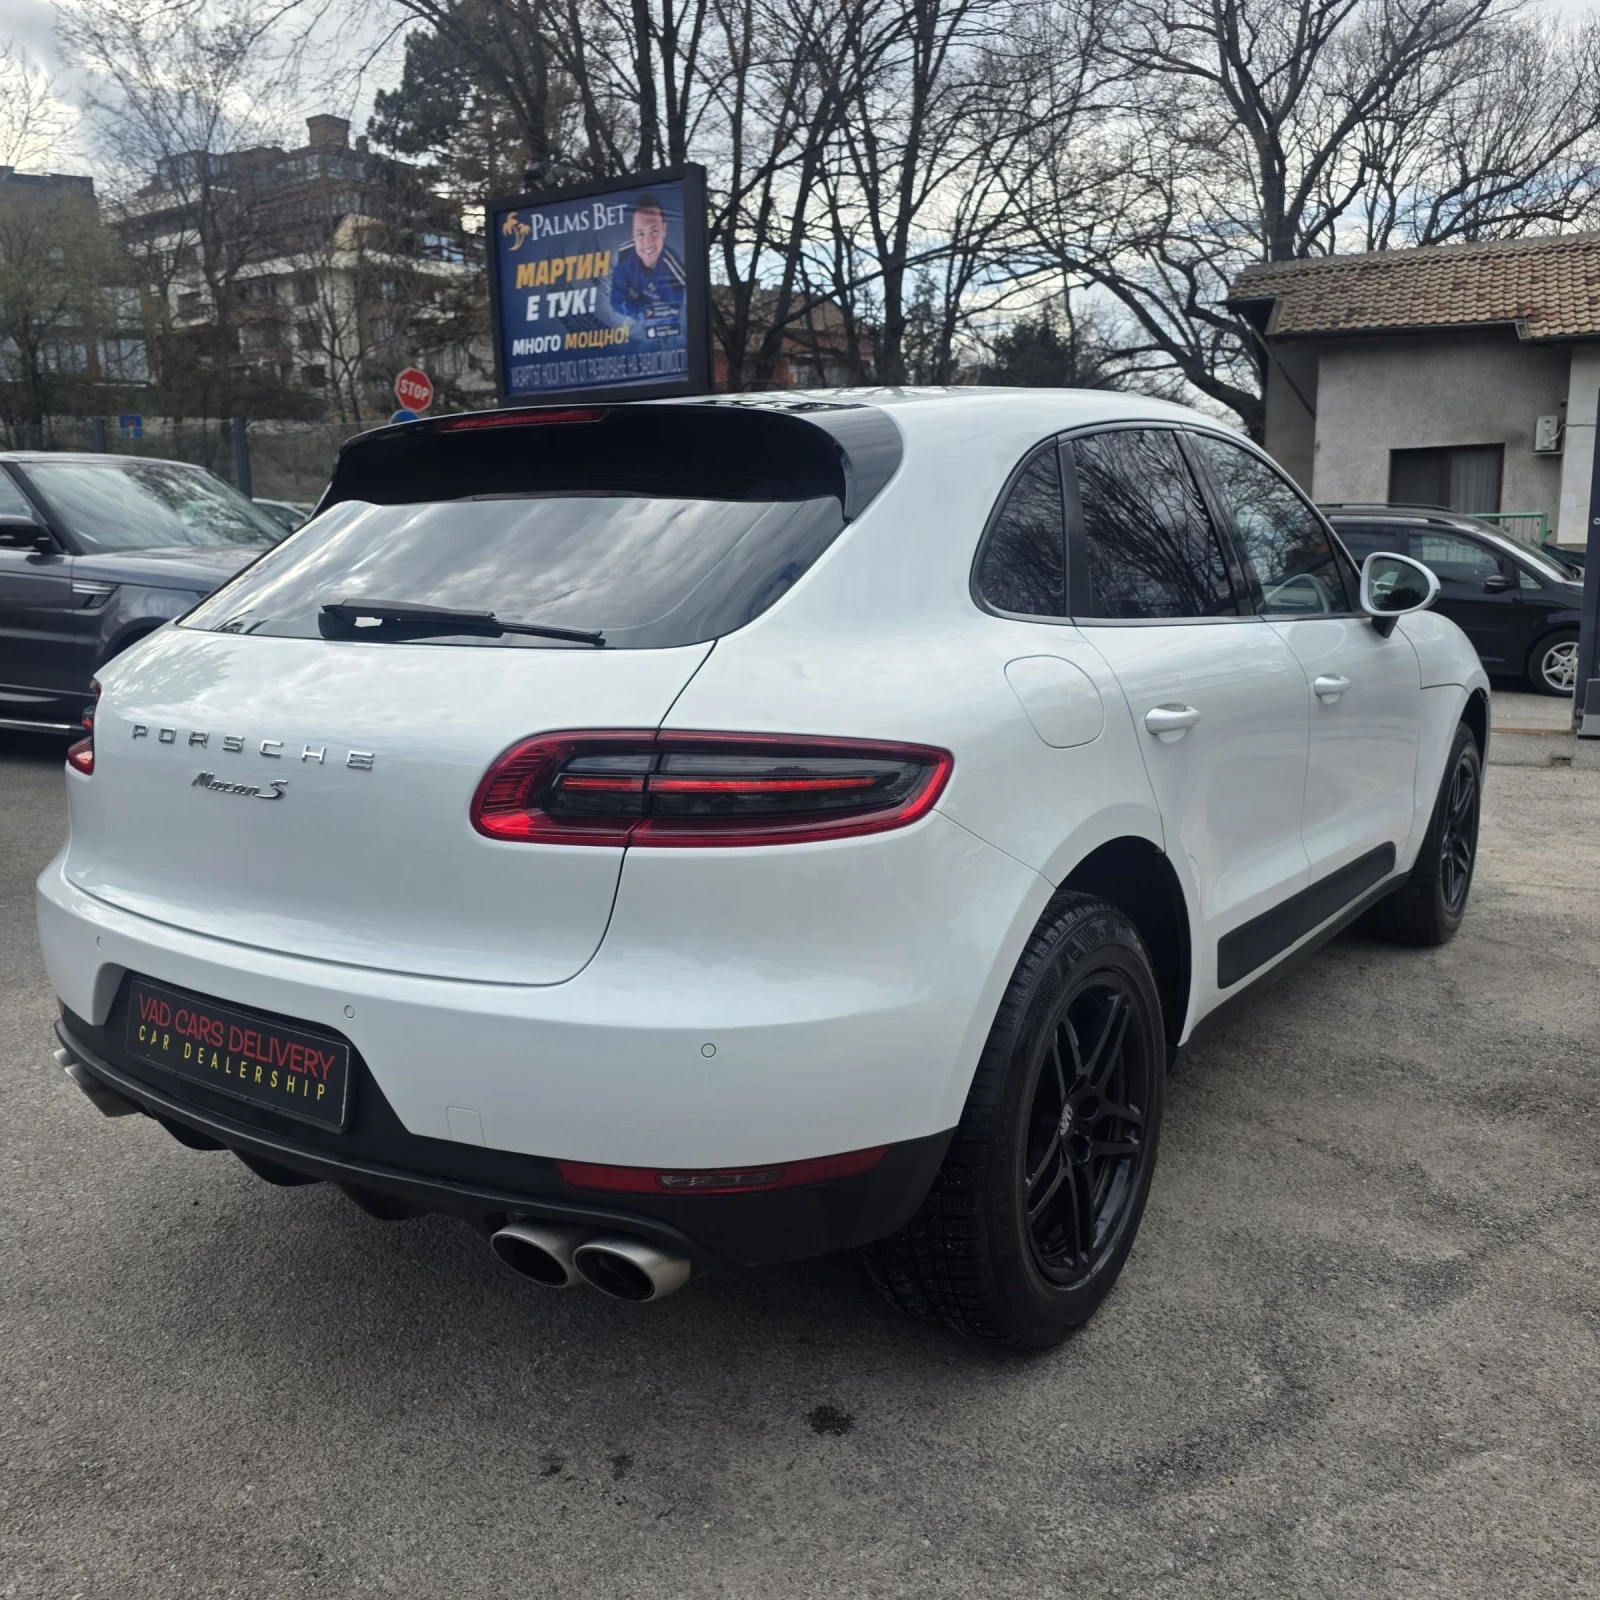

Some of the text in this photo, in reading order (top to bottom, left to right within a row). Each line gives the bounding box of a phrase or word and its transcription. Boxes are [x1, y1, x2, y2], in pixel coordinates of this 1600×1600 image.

[530, 202, 628, 241] PALMS BET
[515, 251, 611, 289] МАРТИН
[526, 287, 598, 322] Е ТУК!
[512, 325, 631, 356] МНОГО МОЩНО!
[400, 379, 430, 401] STOP
[132, 724, 375, 771] PORSCHE
[191, 770, 260, 797] Macan
[139, 994, 336, 1081] VAD CARS DELIVERY
[139, 1025, 326, 1101] CAR DEALERSHIP
